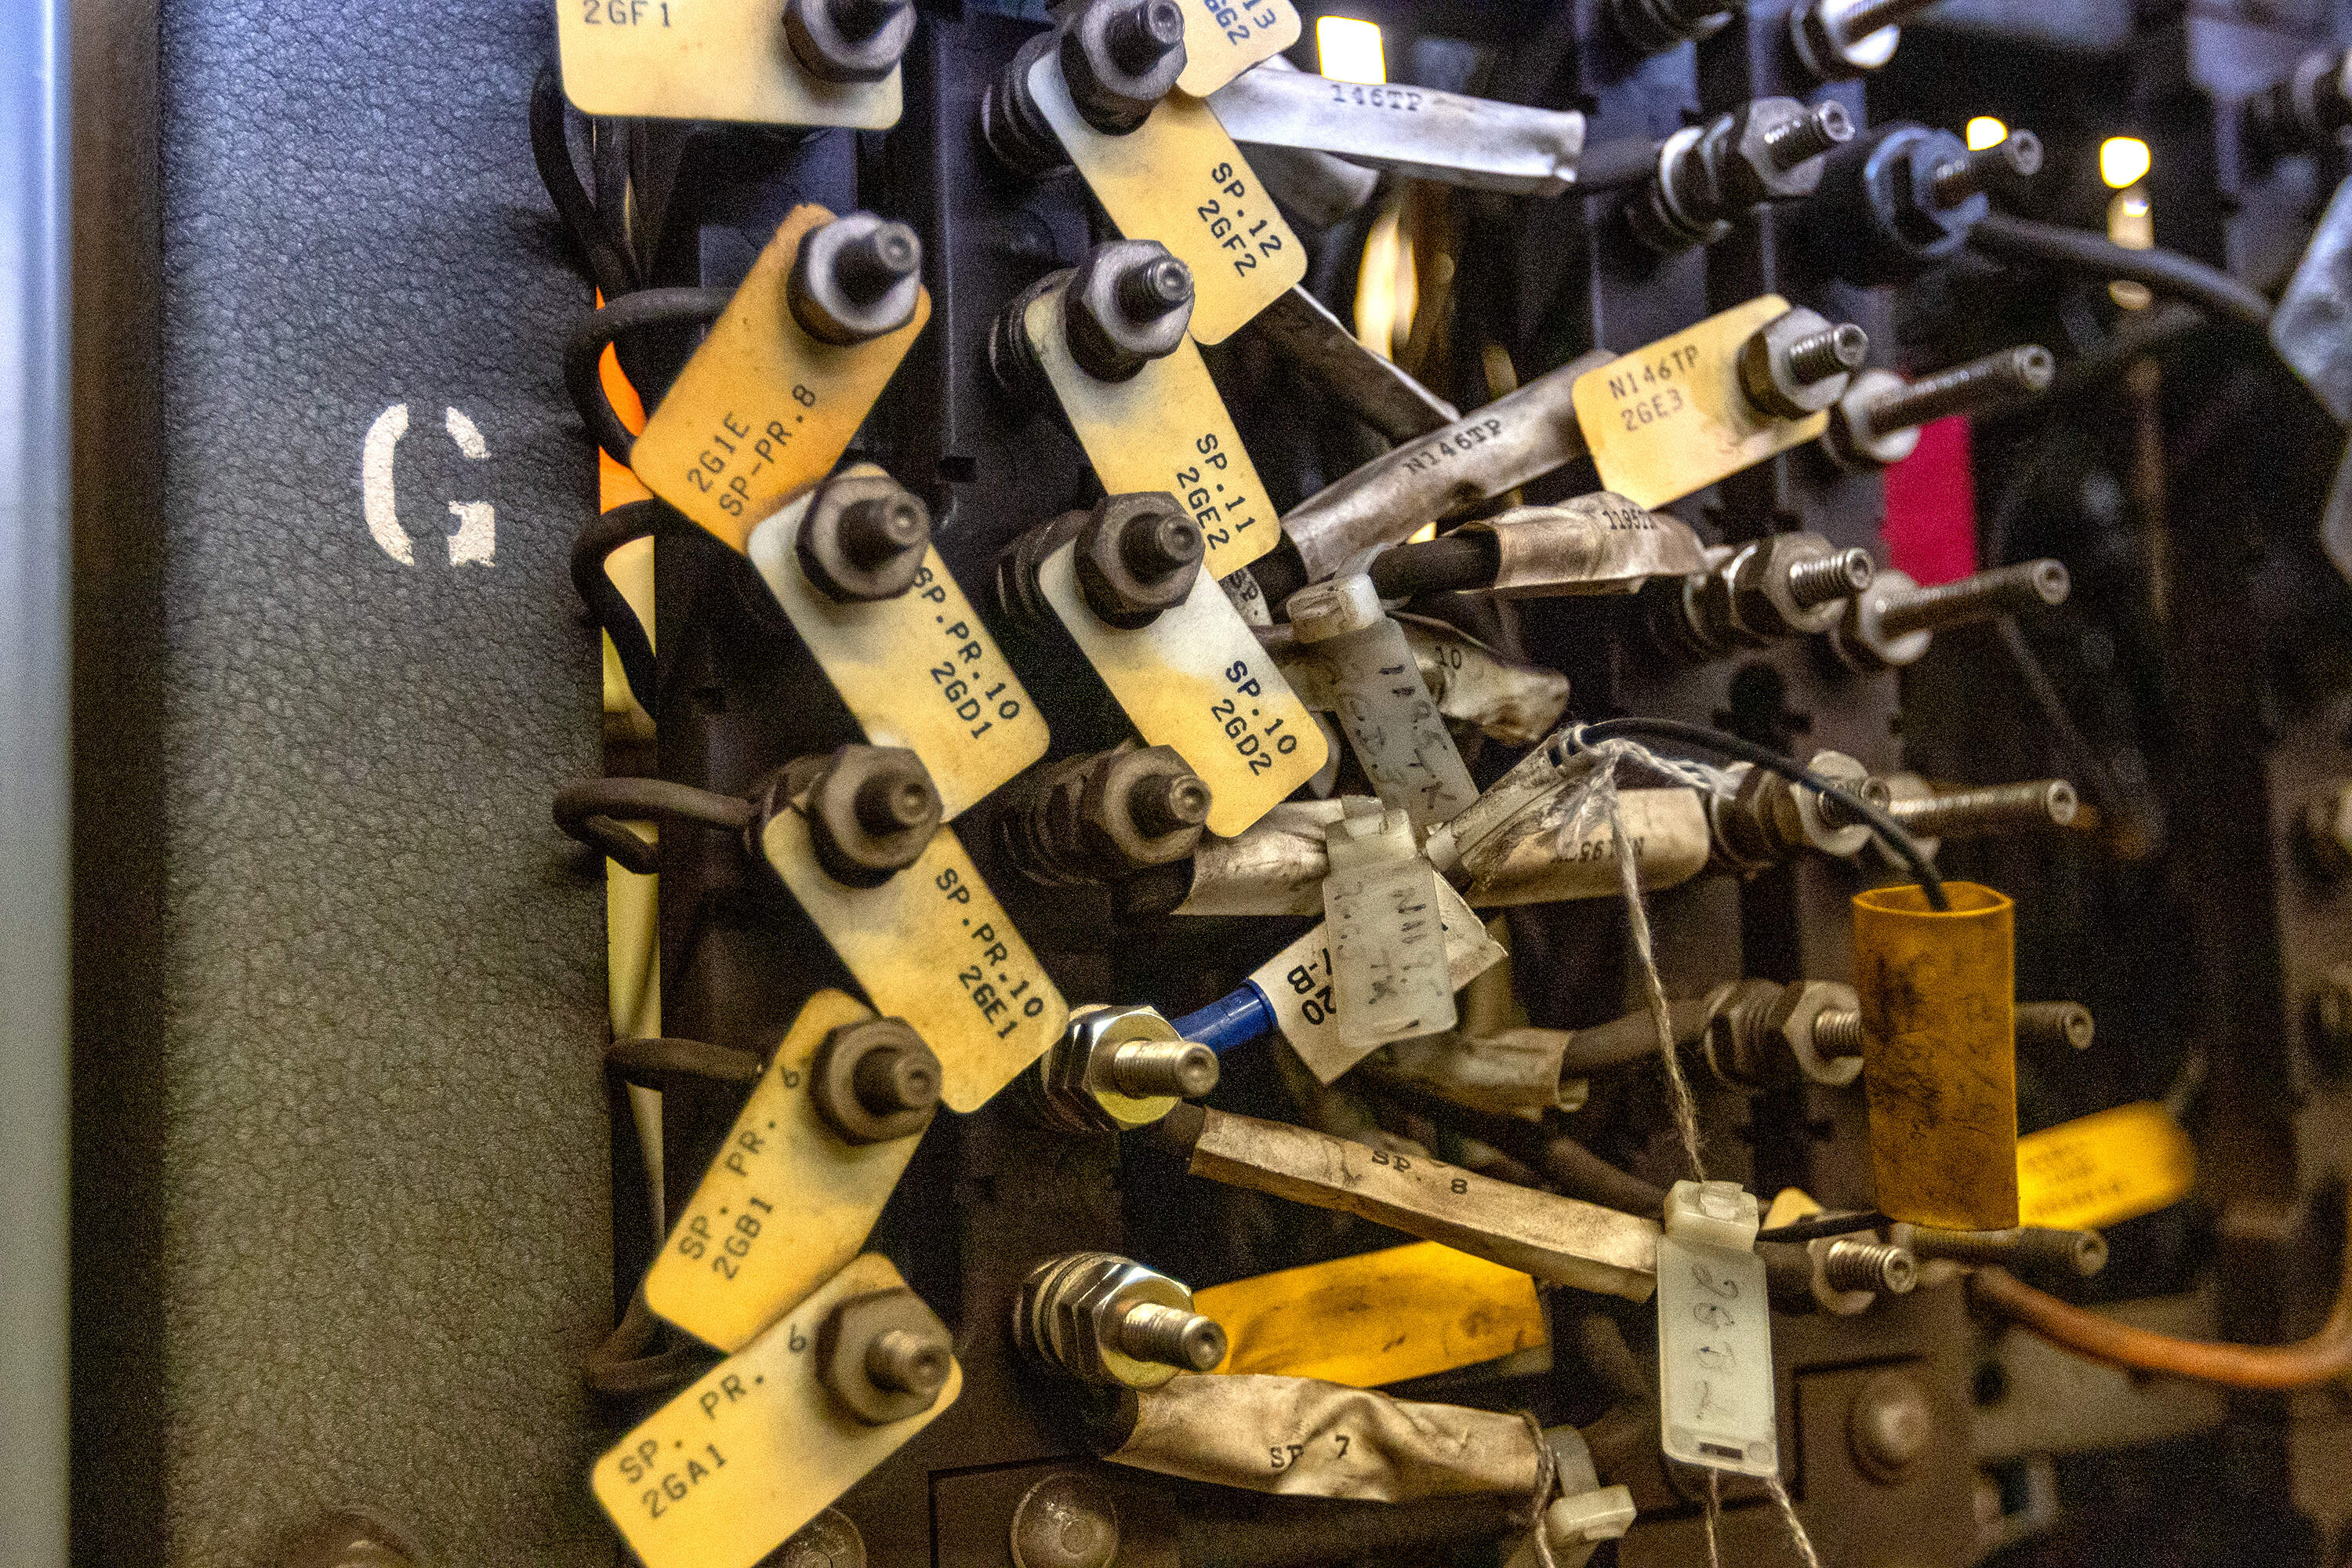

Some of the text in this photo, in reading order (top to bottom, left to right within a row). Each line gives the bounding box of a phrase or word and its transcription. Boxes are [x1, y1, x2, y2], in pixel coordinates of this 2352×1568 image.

[583, 0, 670, 27] 2GF1
[1330, 83, 1422, 111] 146TP
[1198, 199, 1257, 278] 2GF2
[1211, 162, 1283, 258] SP.12
[1609, 344, 1699, 401] N146TP
[1620, 388, 1683, 432] 2GE3
[687, 411, 750, 493] 2G1E
[1196, 434, 1256, 533] SP.11
[1403, 419, 1501, 472] N146TP
[362, 403, 495, 567] G
[1177, 466, 1230, 550] 2GE2
[930, 661, 993, 739] 2GD1
[1211, 699, 1272, 776] 2GD2
[1225, 660, 1298, 755] SP.10
[959, 965, 1018, 1039] 2GE1
[782, 1065, 800, 1090] 6
[1450, 1178, 1468, 1195] 8
[712, 1196, 774, 1281] 2GB1
[788, 1323, 807, 1353] 6
[641, 1443, 727, 1519] 2GA1
[1335, 1435, 1350, 1458] 7
